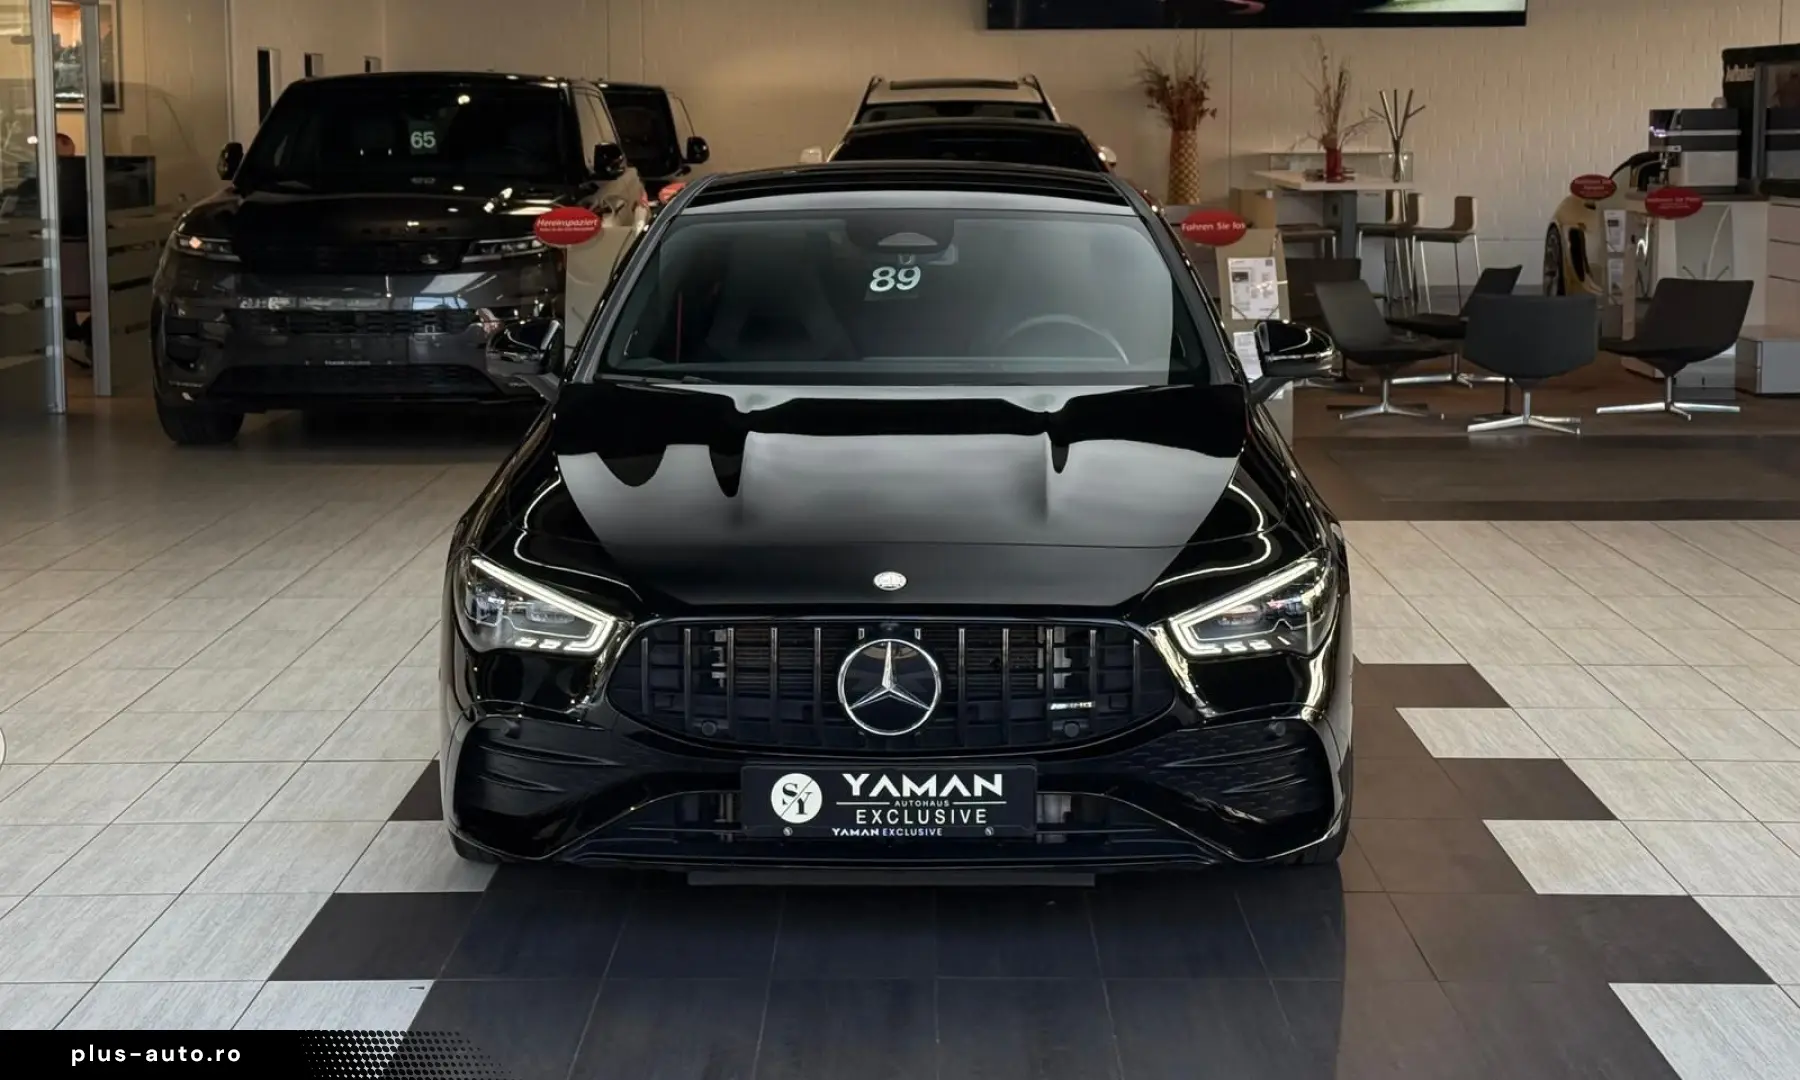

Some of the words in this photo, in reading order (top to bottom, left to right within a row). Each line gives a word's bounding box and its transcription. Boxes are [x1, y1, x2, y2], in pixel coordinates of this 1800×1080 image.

[410, 131, 436, 148] 65
[1181, 223, 1214, 231] Fahren
[1216, 222, 1230, 230] Sie
[869, 266, 921, 292] 89
[842, 773, 1003, 797] YAMAN
[894, 800, 950, 808] AUTOHAUS
[856, 809, 987, 825] EXCLUSIVE
[832, 828, 880, 836] YAMAN
[882, 828, 943, 837] EXCLUSIVE
